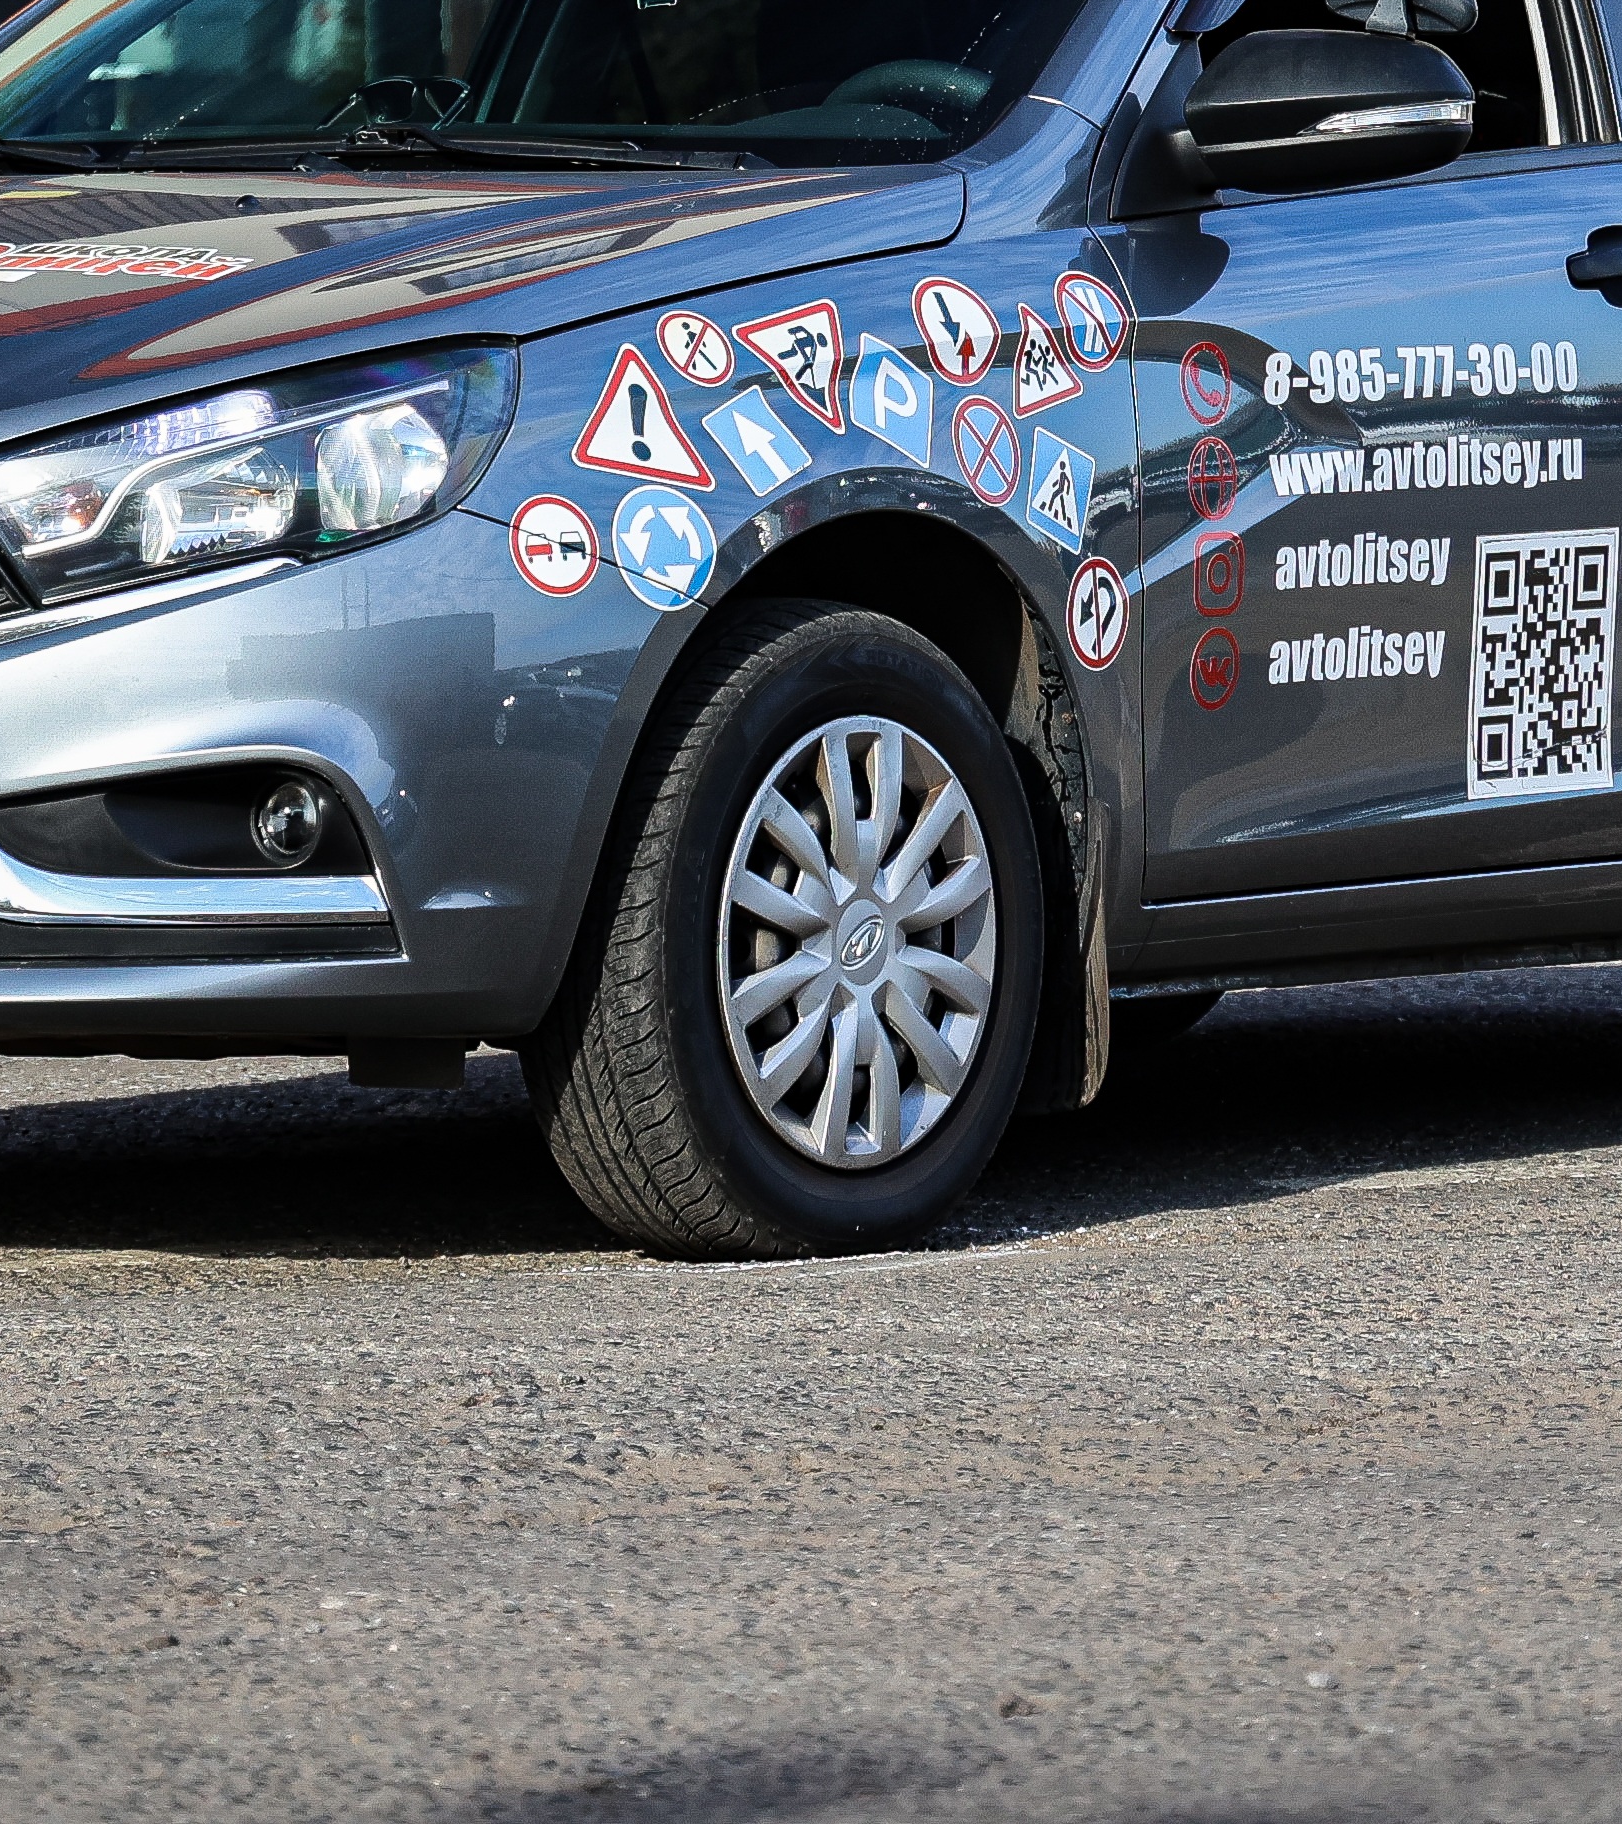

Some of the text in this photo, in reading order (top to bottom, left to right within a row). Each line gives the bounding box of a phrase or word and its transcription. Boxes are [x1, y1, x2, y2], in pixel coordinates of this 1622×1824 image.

[1263, 340, 1579, 406] 8-985-777-30-00
[1269, 434, 1584, 498] www.avtolitsey.ru
[1275, 532, 1451, 591] avtolitsey
